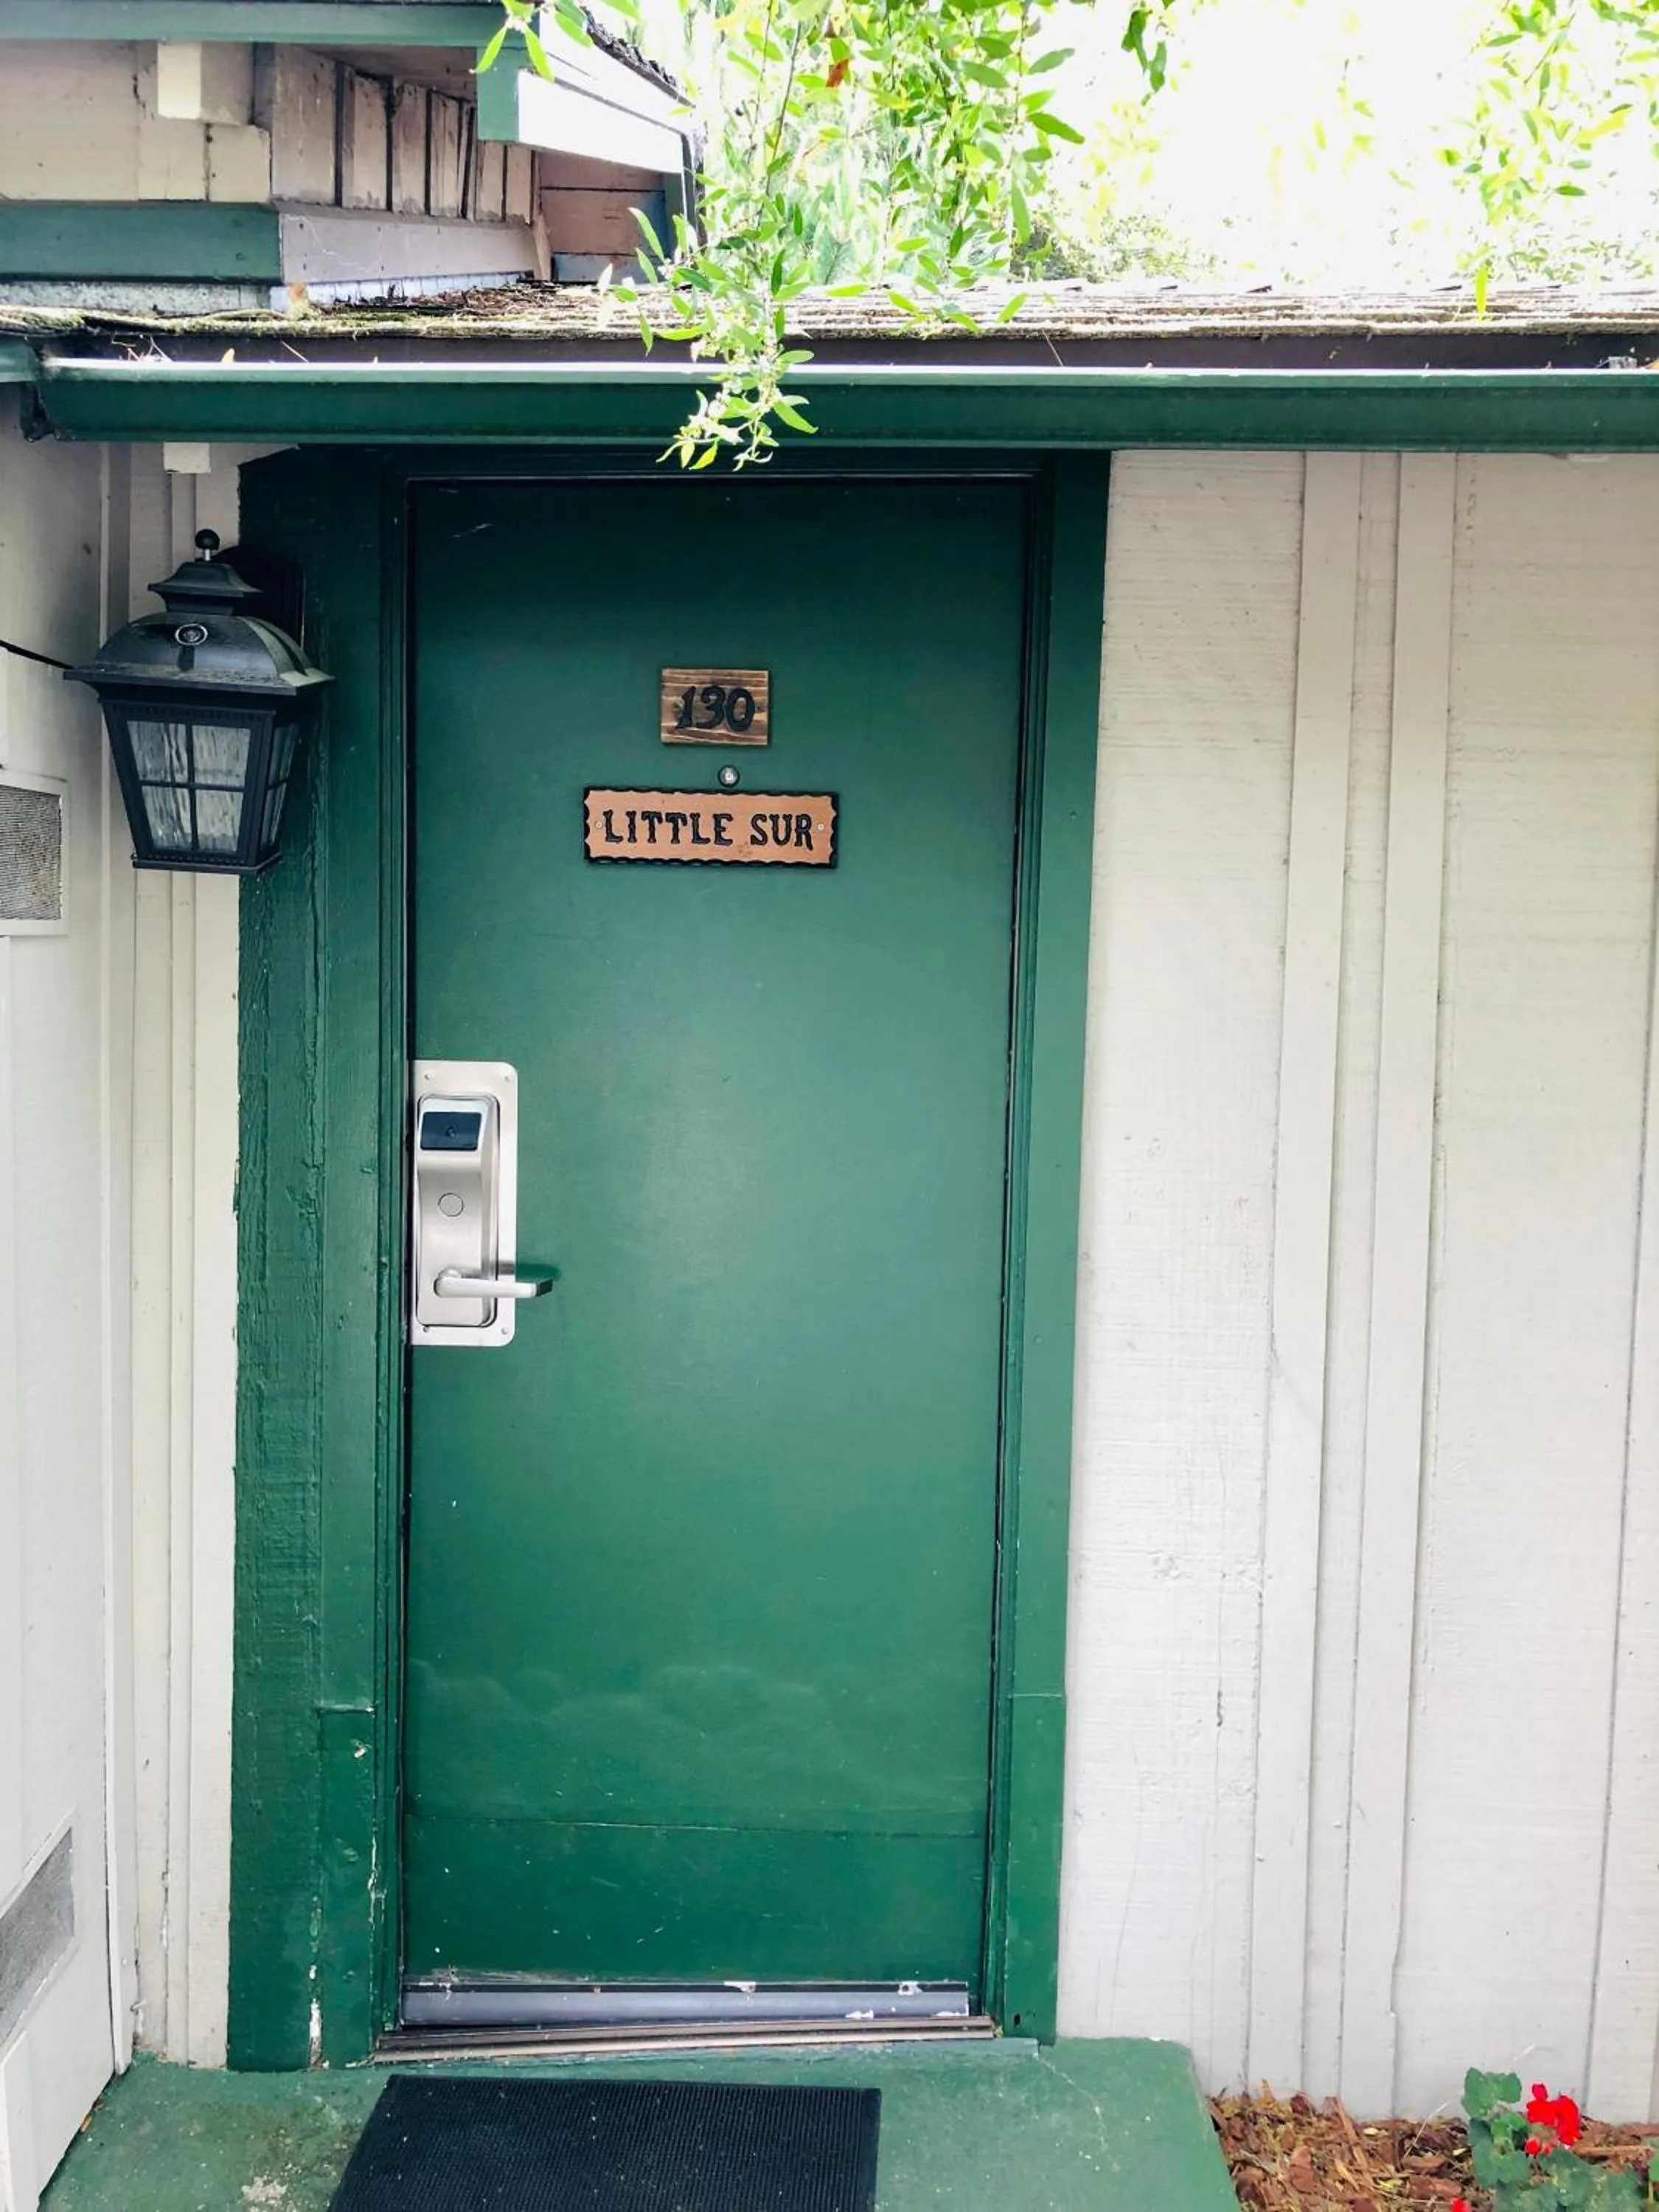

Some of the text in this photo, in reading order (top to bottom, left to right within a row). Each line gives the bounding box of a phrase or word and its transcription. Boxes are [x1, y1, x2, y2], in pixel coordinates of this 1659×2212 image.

[675, 685, 755, 731] 130
[602, 810, 813, 850] LITTLE SUR
